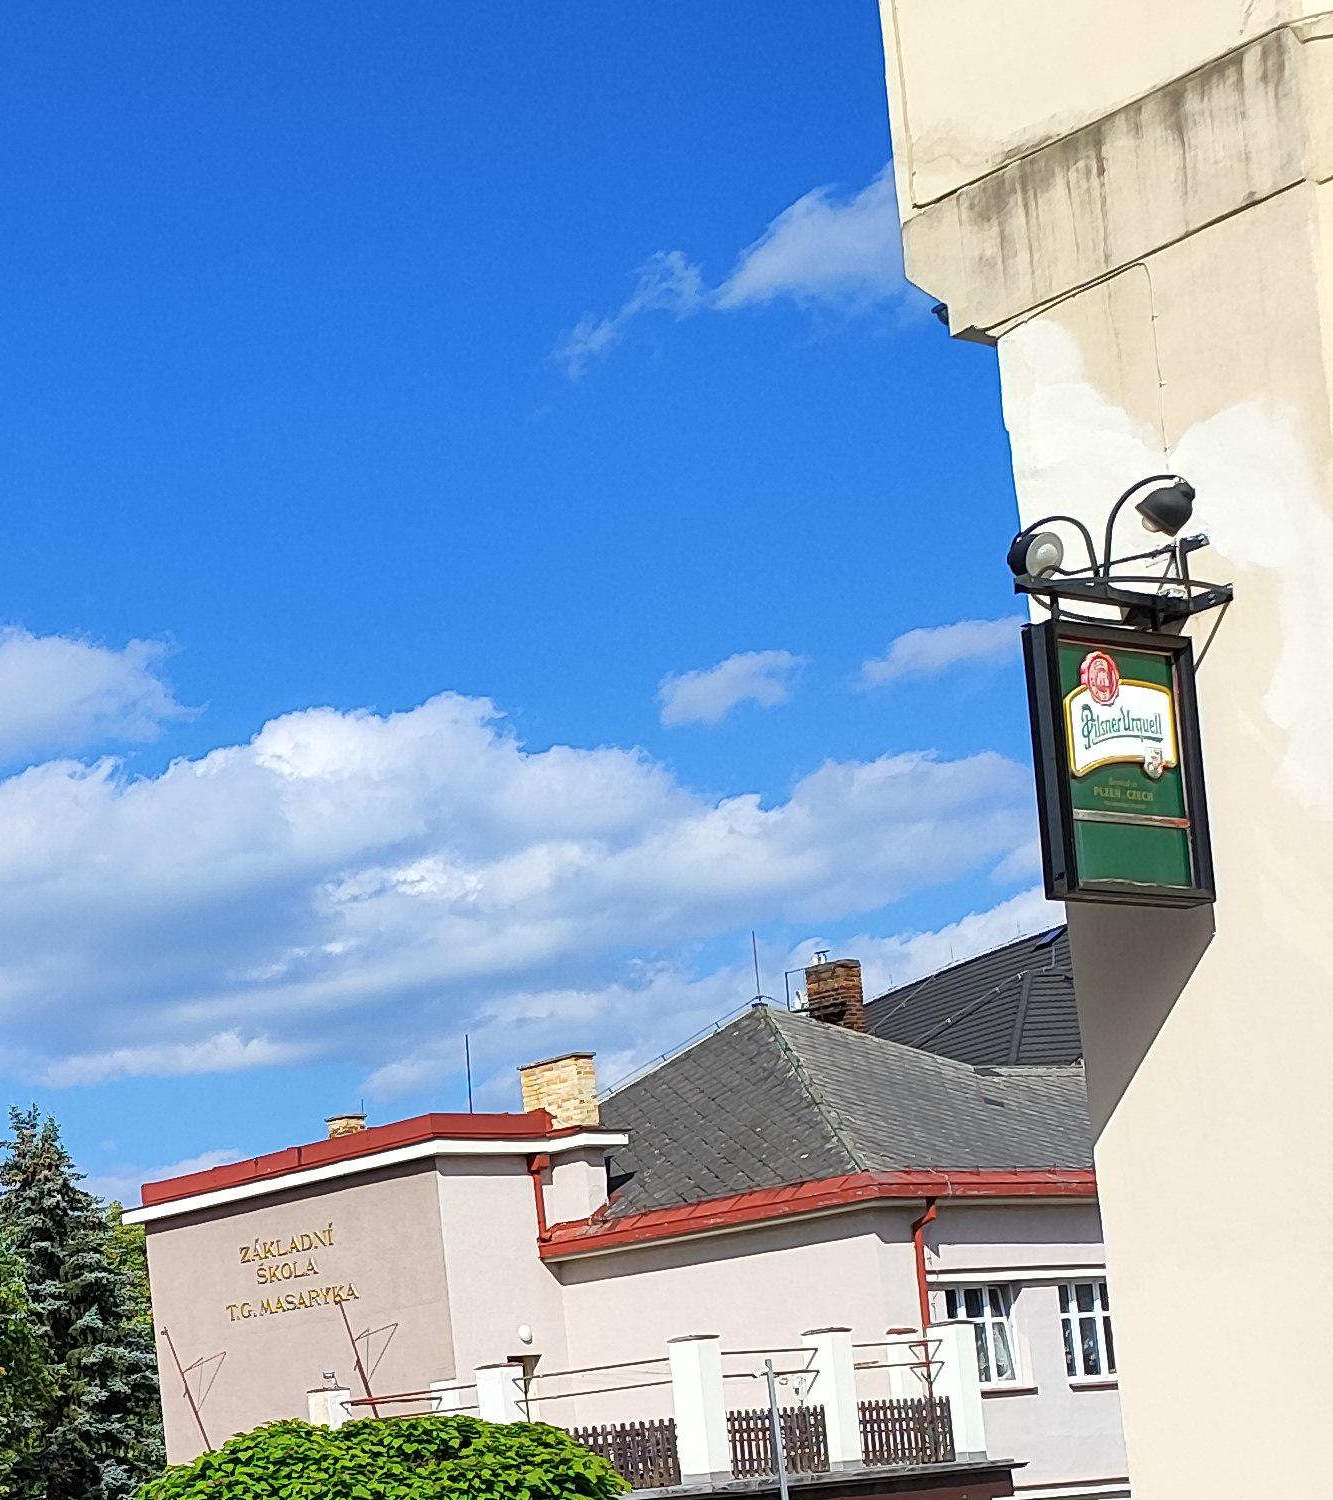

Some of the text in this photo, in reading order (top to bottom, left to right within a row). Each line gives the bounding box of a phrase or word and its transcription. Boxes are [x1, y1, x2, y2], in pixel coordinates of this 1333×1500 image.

[1081, 704, 1163, 750] Pilsner Urquell
[239, 1222, 334, 1264] ZÁKLADNÍ
[256, 1257, 319, 1284] ŠKOLA
[259, 1283, 360, 1316] MASARYKA
